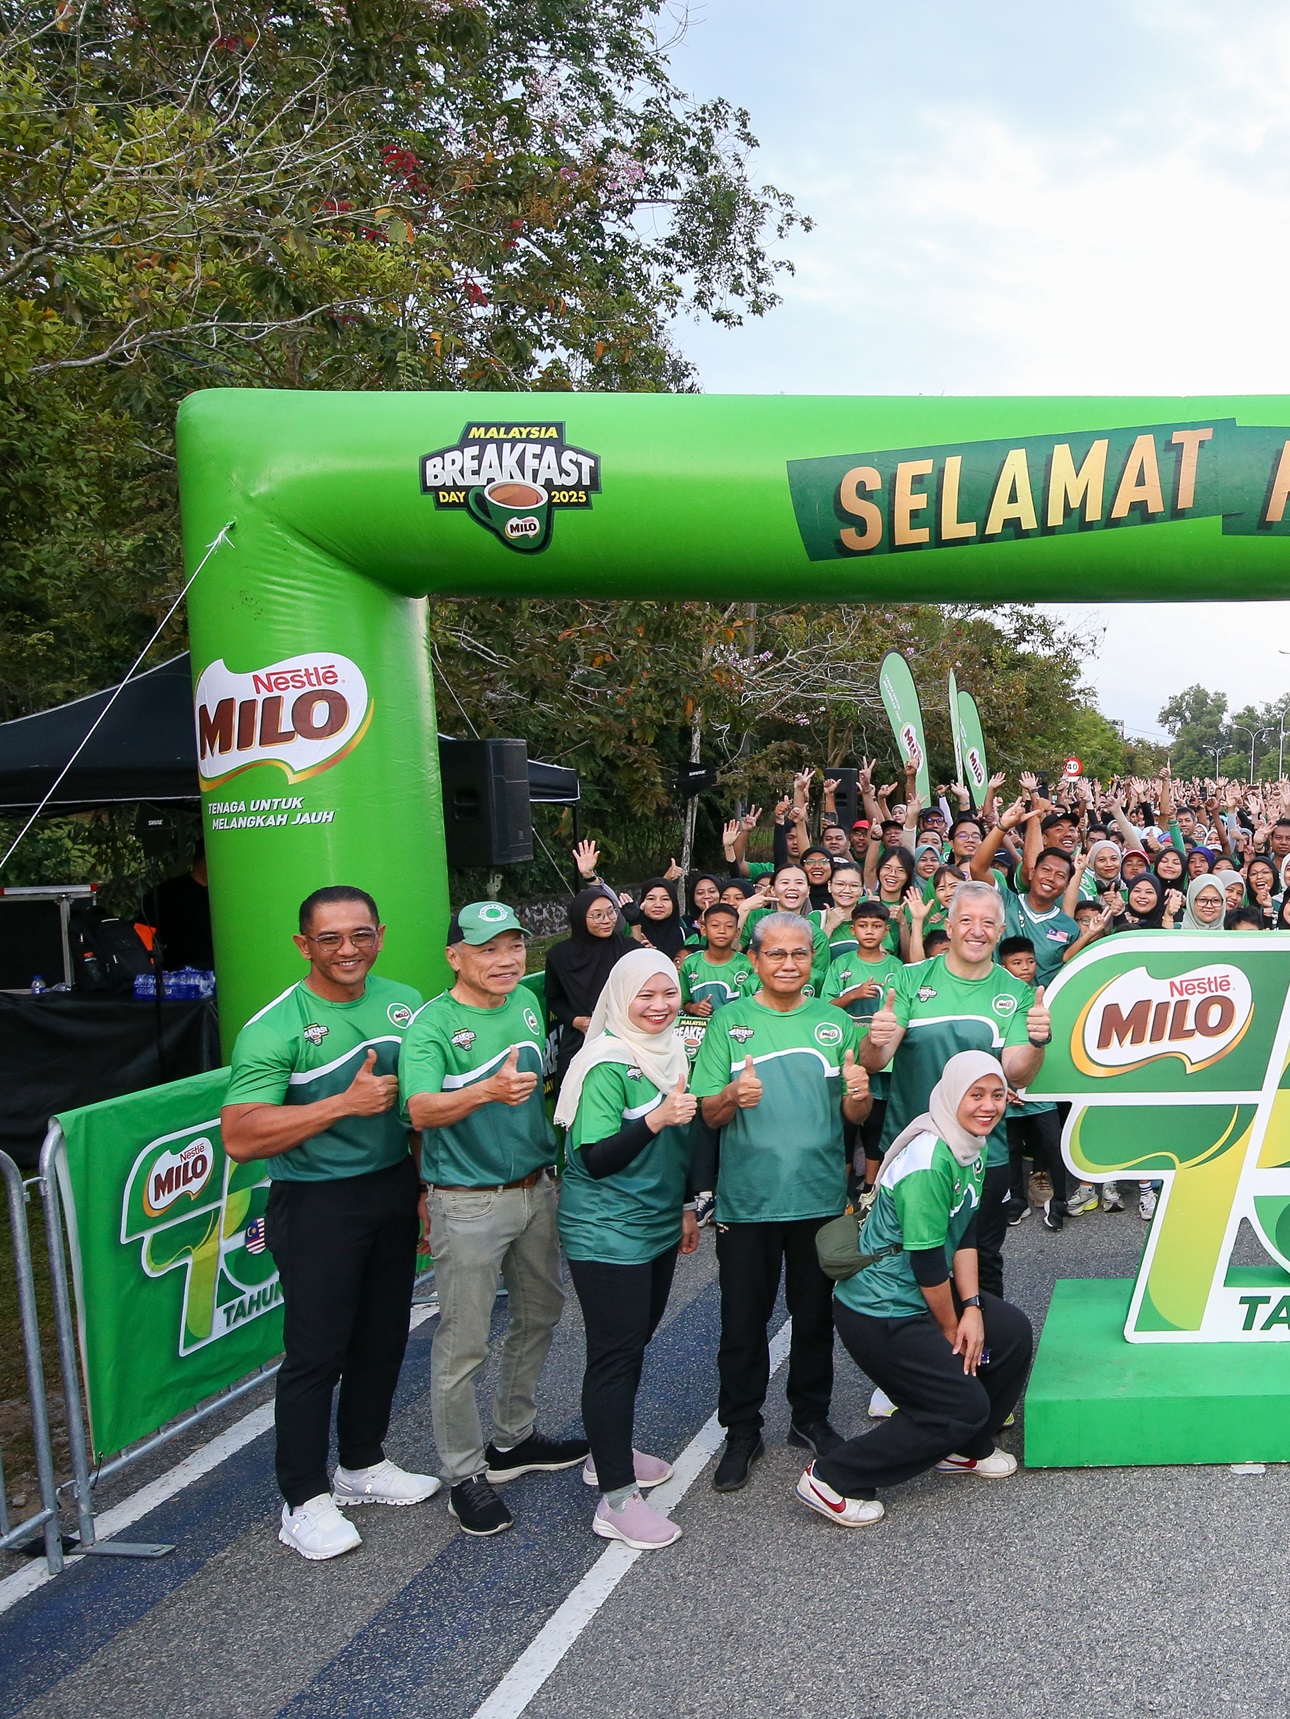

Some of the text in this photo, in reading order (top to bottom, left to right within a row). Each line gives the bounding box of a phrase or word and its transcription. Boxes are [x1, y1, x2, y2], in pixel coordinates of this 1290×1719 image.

[468, 427, 558, 439] MALAYSIA
[425, 442, 595, 487] BREAKFAST
[439, 491, 466, 503] DAY
[551, 490, 587, 503] 2025
[839, 428, 1214, 551] SELAMAT
[510, 523, 537, 534] MILO
[251, 665, 339, 694] Nestlé
[199, 689, 348, 761] MILO
[970, 752, 982, 784] MILO
[1067, 763, 1078, 771] 40
[208, 797, 305, 815] TENAGA UNTUK
[212, 811, 335, 830] MELANGKAH JAUH
[1169, 974, 1231, 997] Nestlé
[1097, 994, 1237, 1050] MILO
[154, 1154, 208, 1202] MILO
